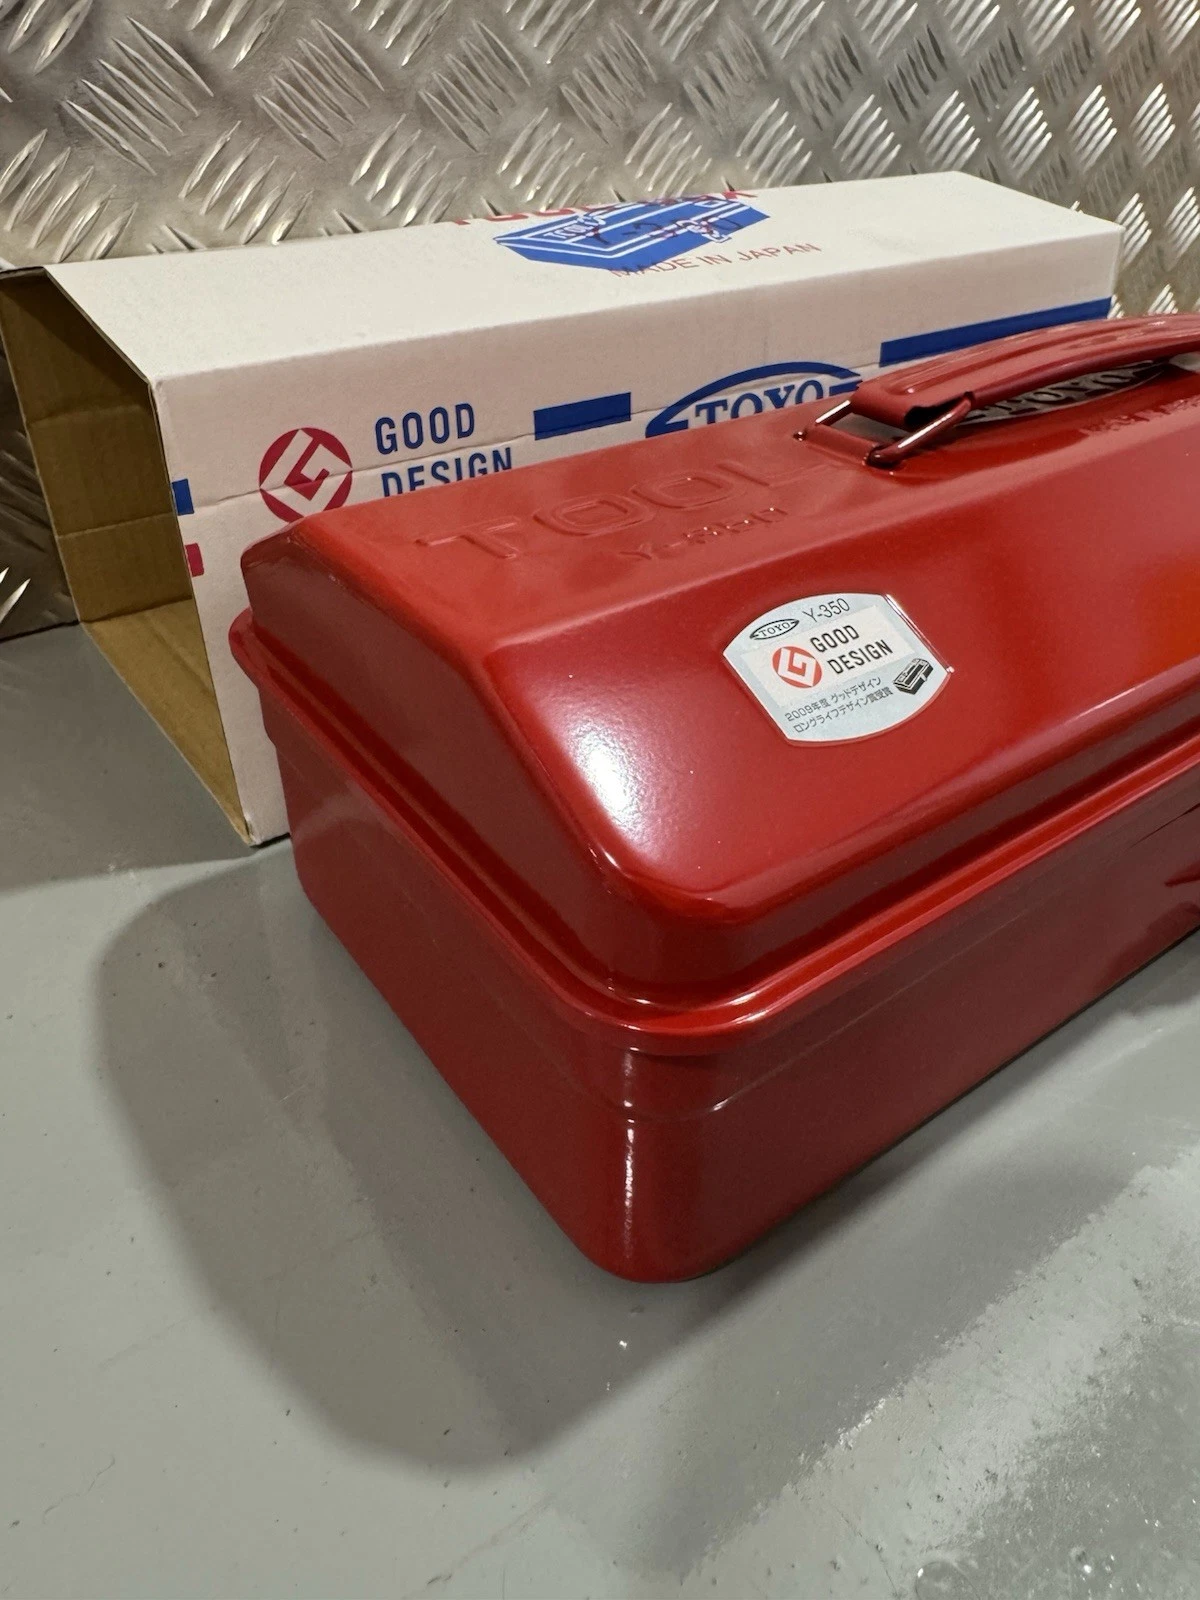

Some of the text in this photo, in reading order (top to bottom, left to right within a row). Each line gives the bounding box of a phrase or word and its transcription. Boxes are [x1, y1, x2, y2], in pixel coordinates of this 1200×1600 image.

[608, 242, 822, 278] MADE IN JAPAN
[694, 379, 824, 425] TOYO
[374, 402, 476, 456] GOOD
[381, 446, 513, 498] DESIGN
[414, 460, 834, 561] TOOL
[759, 597, 851, 639] TOYO Y-350
[809, 624, 860, 654] GOOD
[826, 638, 894, 675] DESIGN
[829, 676, 882, 703] グッドデザイン
